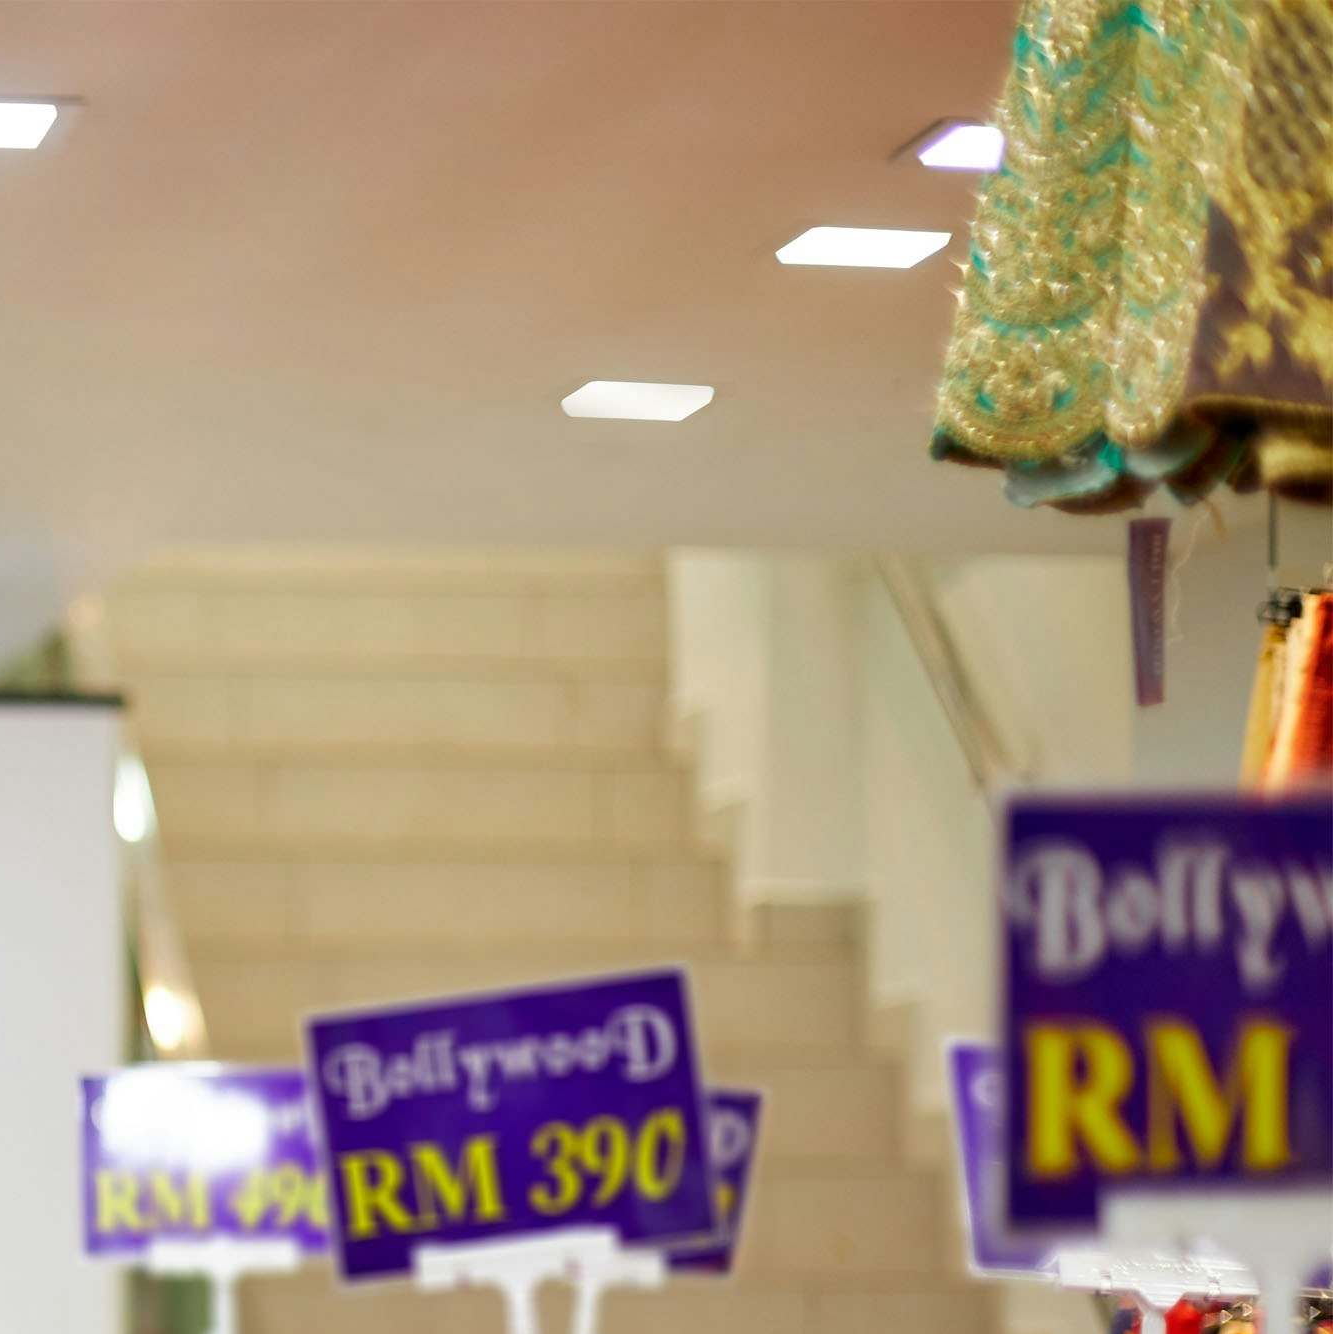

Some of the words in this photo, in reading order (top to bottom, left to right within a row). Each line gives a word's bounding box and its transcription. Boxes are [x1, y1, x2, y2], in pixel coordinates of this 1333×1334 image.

[1025, 1020, 1292, 1179] RM
[96, 1170, 211, 1234] RM
[342, 1134, 507, 1240] RM
[530, 1107, 686, 1216] 390
